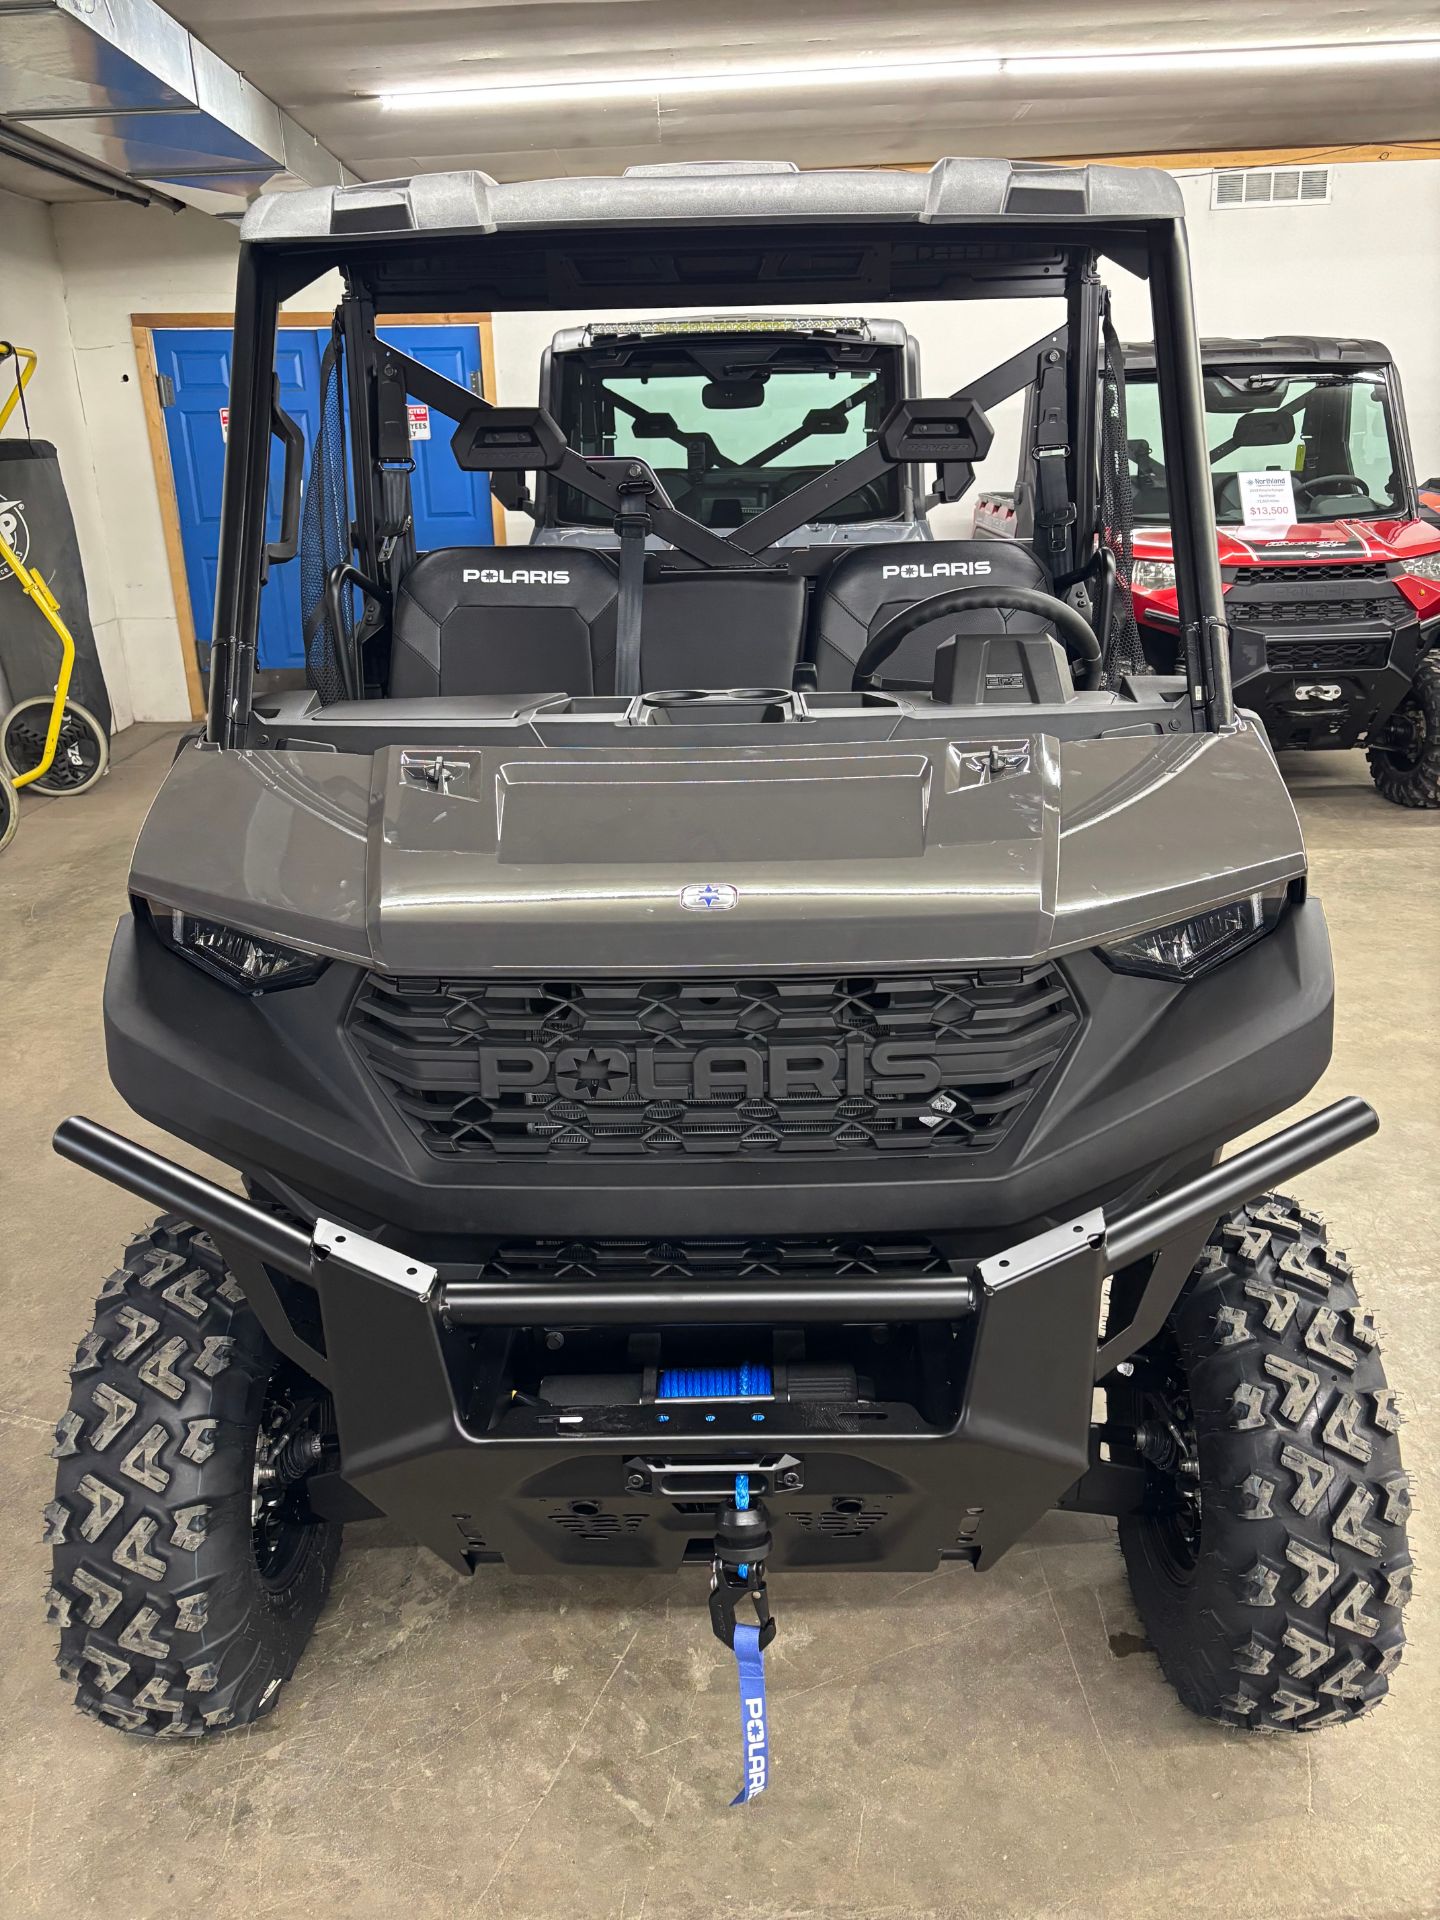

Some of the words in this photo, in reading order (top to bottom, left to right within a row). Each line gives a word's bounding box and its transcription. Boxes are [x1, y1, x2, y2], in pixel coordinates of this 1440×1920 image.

[1250, 506, 1289, 515] $13,500
[463, 569, 570, 584] POLARIS
[882, 561, 992, 580] POLARIS
[479, 1041, 942, 1100] POLARIS
